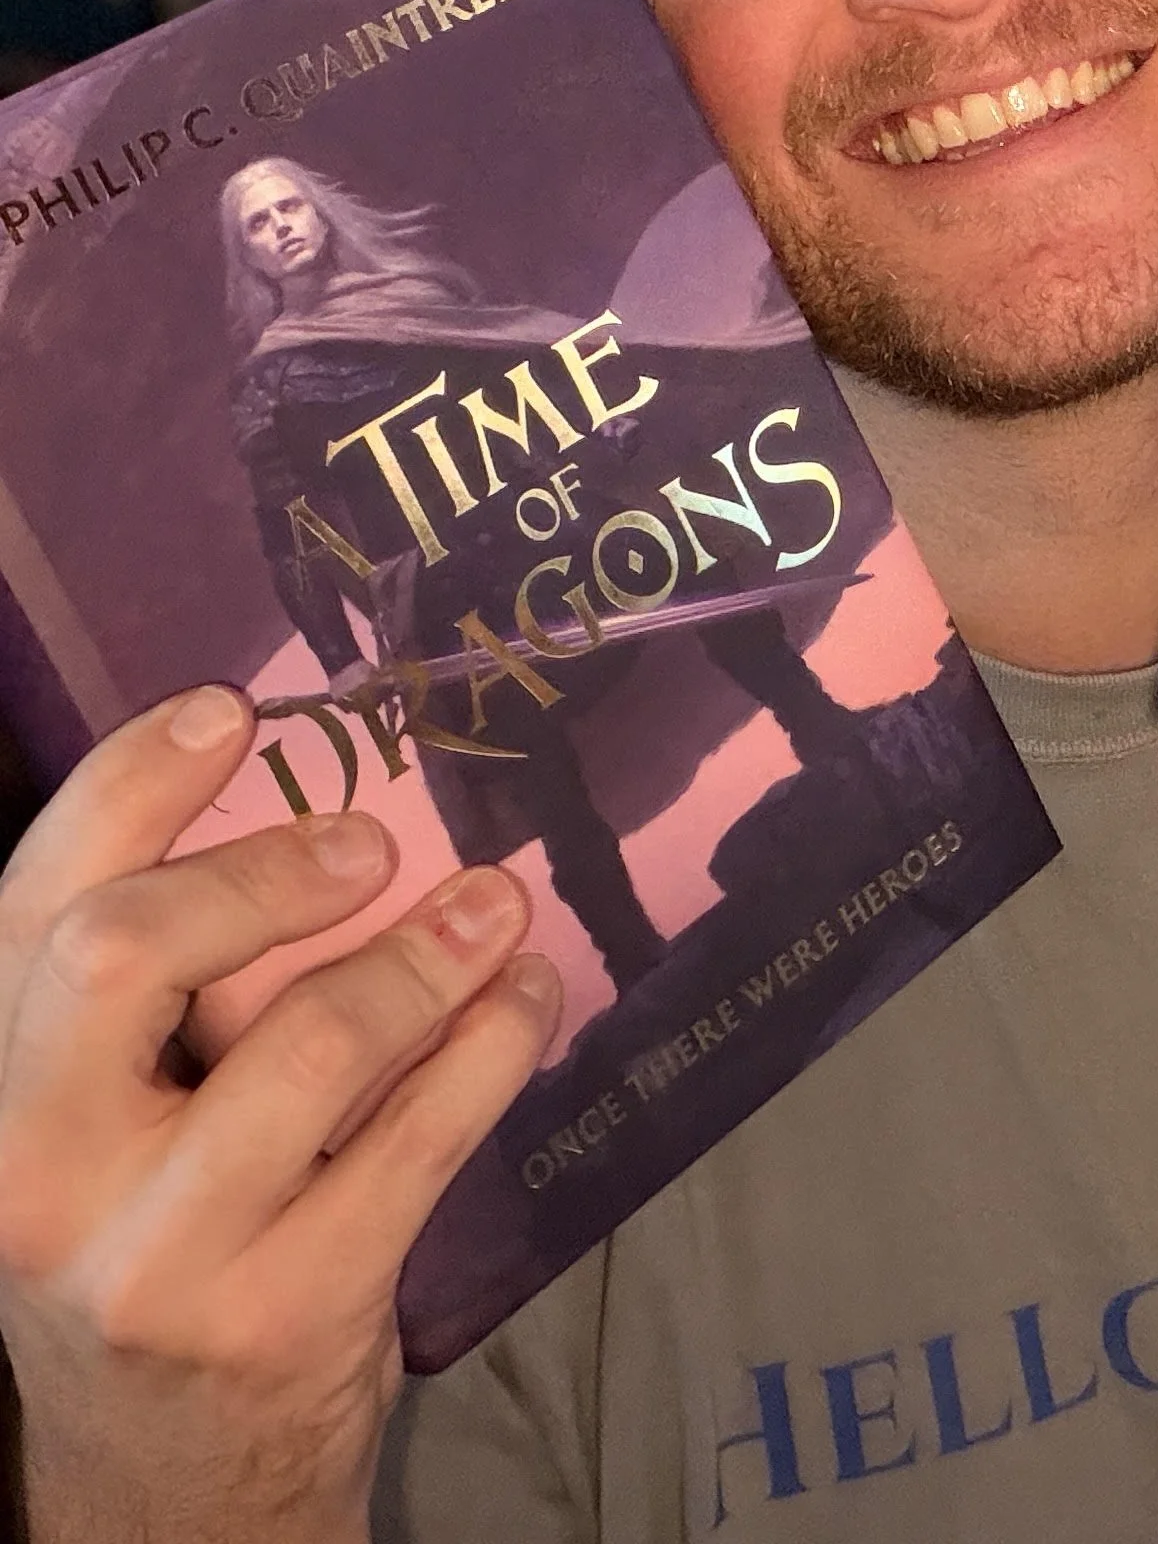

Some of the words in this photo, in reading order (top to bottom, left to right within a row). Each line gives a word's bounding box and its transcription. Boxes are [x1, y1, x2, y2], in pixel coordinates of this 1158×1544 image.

[0, 129, 172, 246] PHILIP
[182, 104, 239, 149] C.
[325, 309, 661, 568] TIME
[515, 462, 581, 542] OF
[256, 406, 842, 814] DRAGONS
[285, 494, 379, 599] A
[522, 1090, 628, 1190] ONCE
[624, 997, 742, 1103] THERE
[738, 919, 839, 1008] WERE
[837, 819, 965, 937] HEROES
